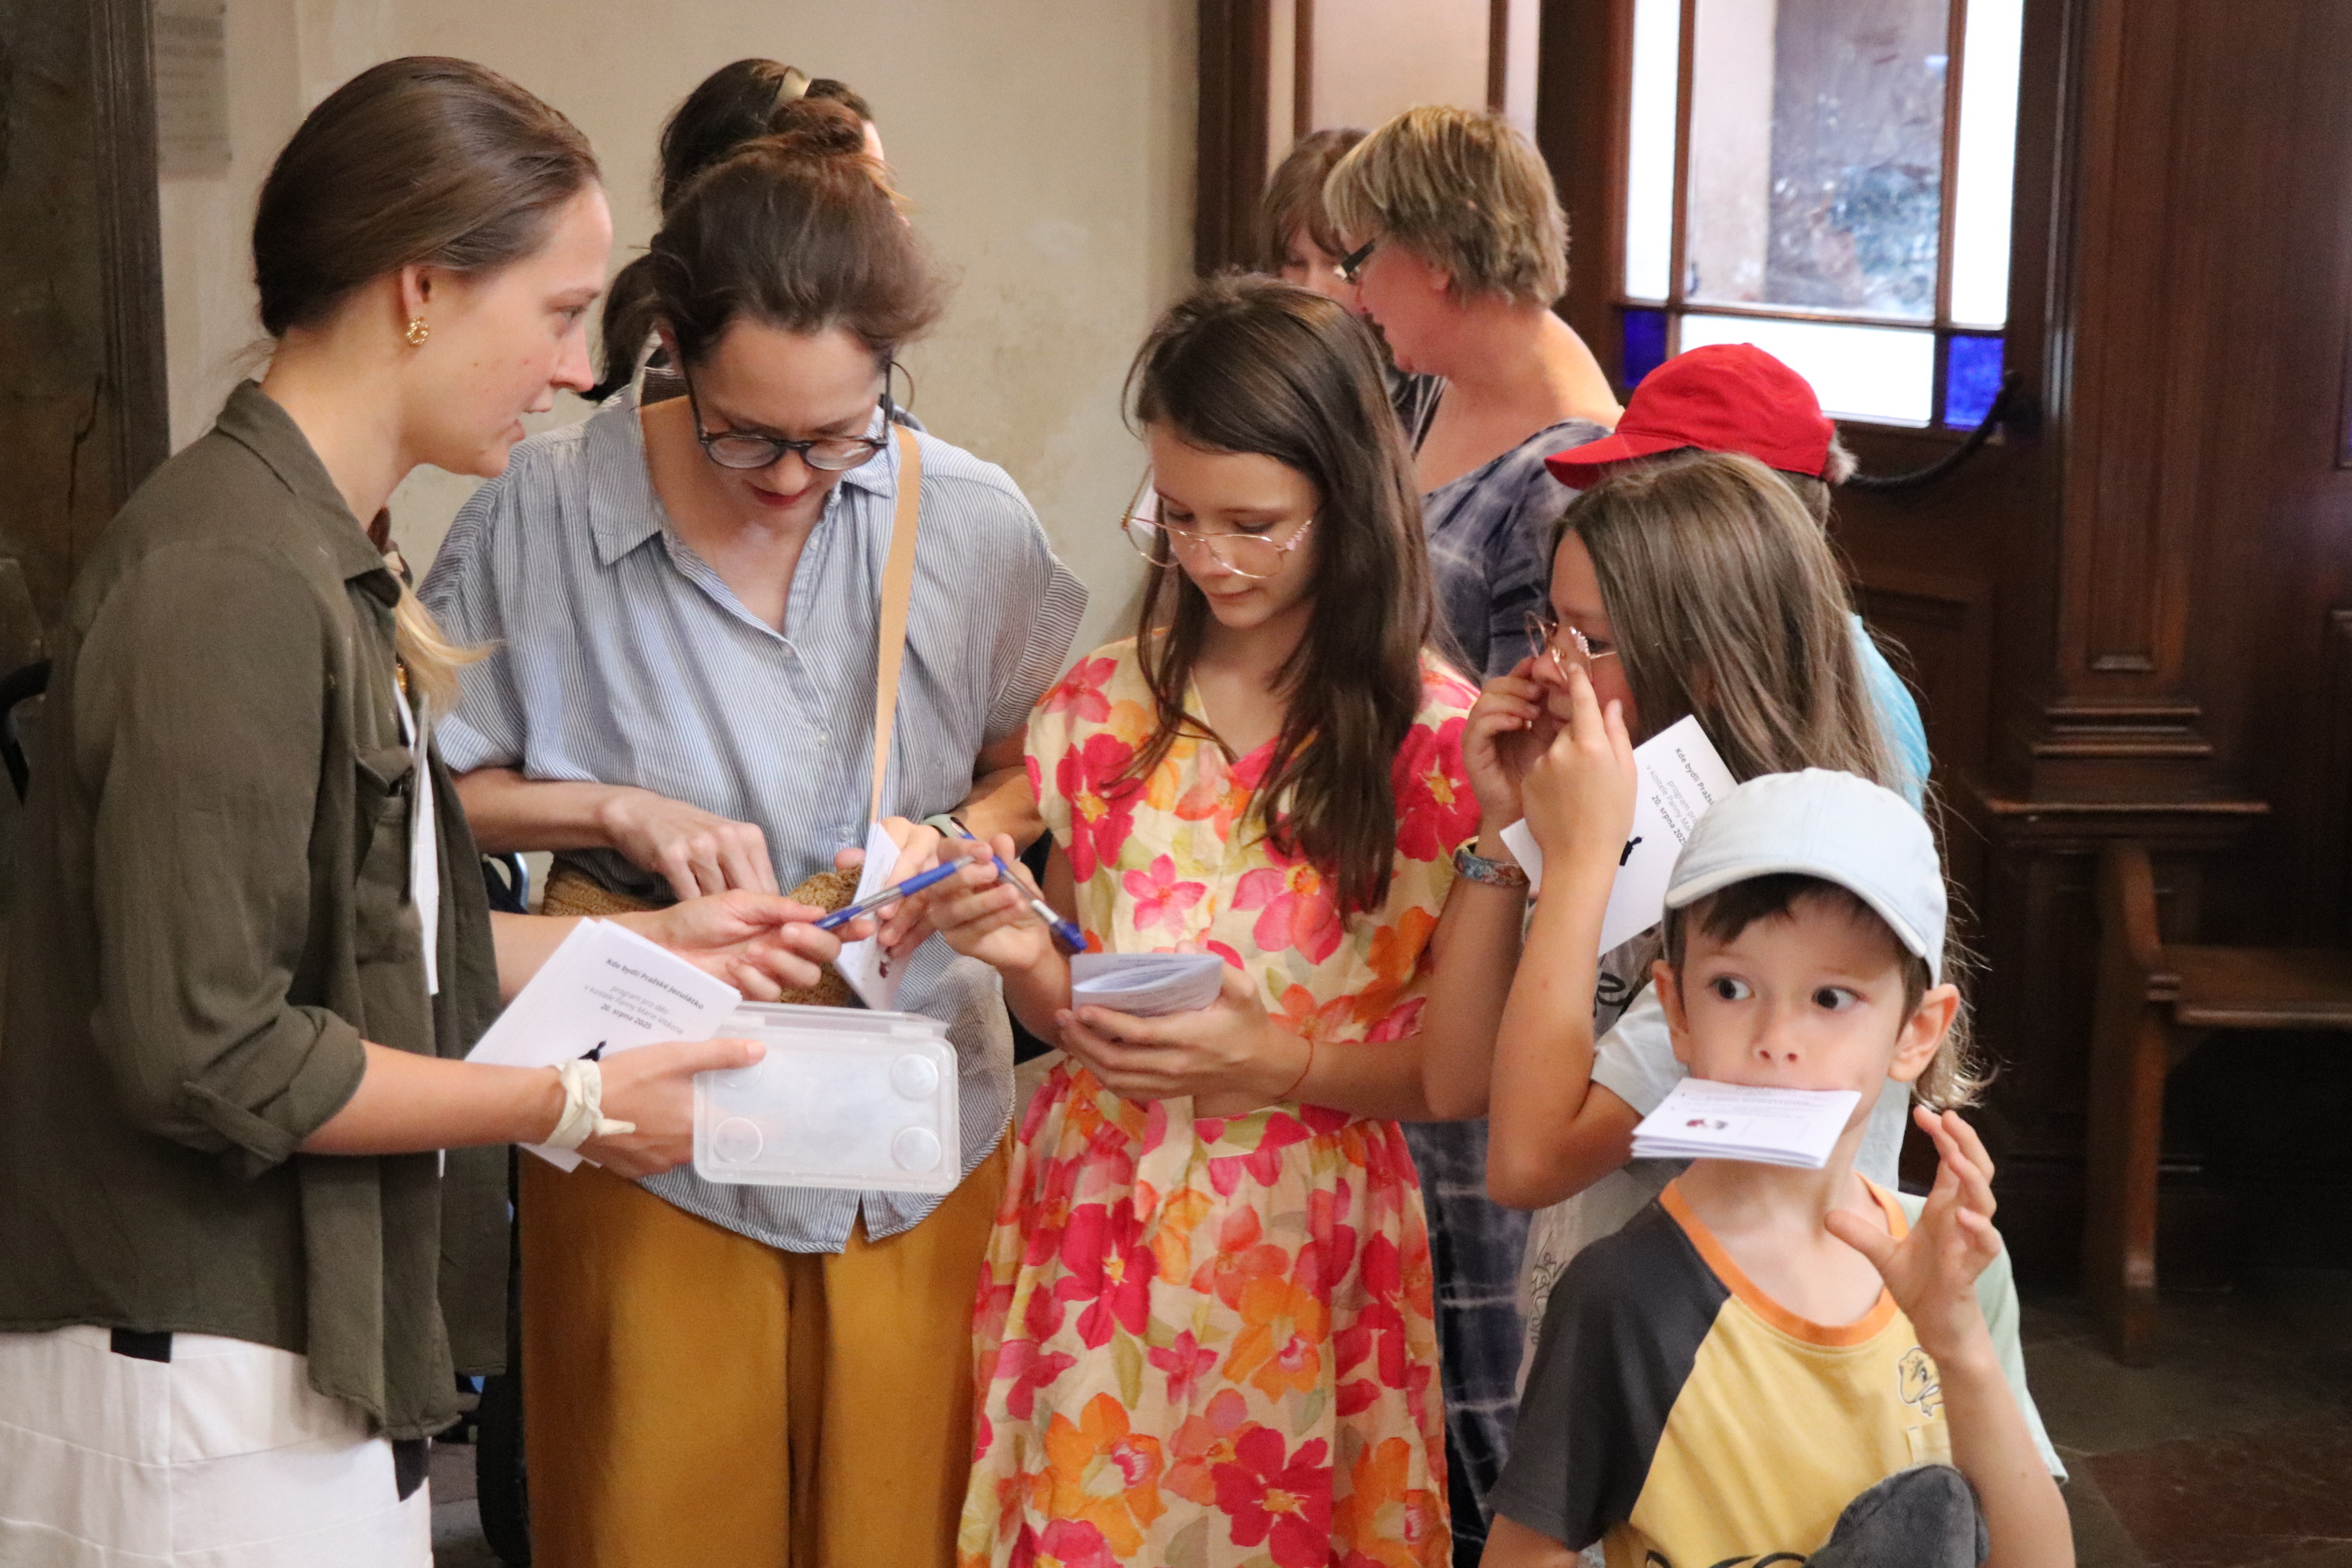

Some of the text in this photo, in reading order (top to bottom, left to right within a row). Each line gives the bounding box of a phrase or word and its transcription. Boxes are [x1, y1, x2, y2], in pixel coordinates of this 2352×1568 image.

[1675, 747, 1687, 763] Kde
[1649, 770, 1668, 796] kostele
[1665, 794, 1683, 819] Panny
[1680, 816, 1694, 835] Mar
[1667, 780, 1690, 811] program
[1651, 794, 1660, 807] 20.
[1659, 807, 1675, 829] srpna
[605, 957, 621, 969] Kde
[639, 997, 655, 1008] pro
[612, 1008, 634, 1021] srpna
[633, 1016, 653, 1030] 2025
